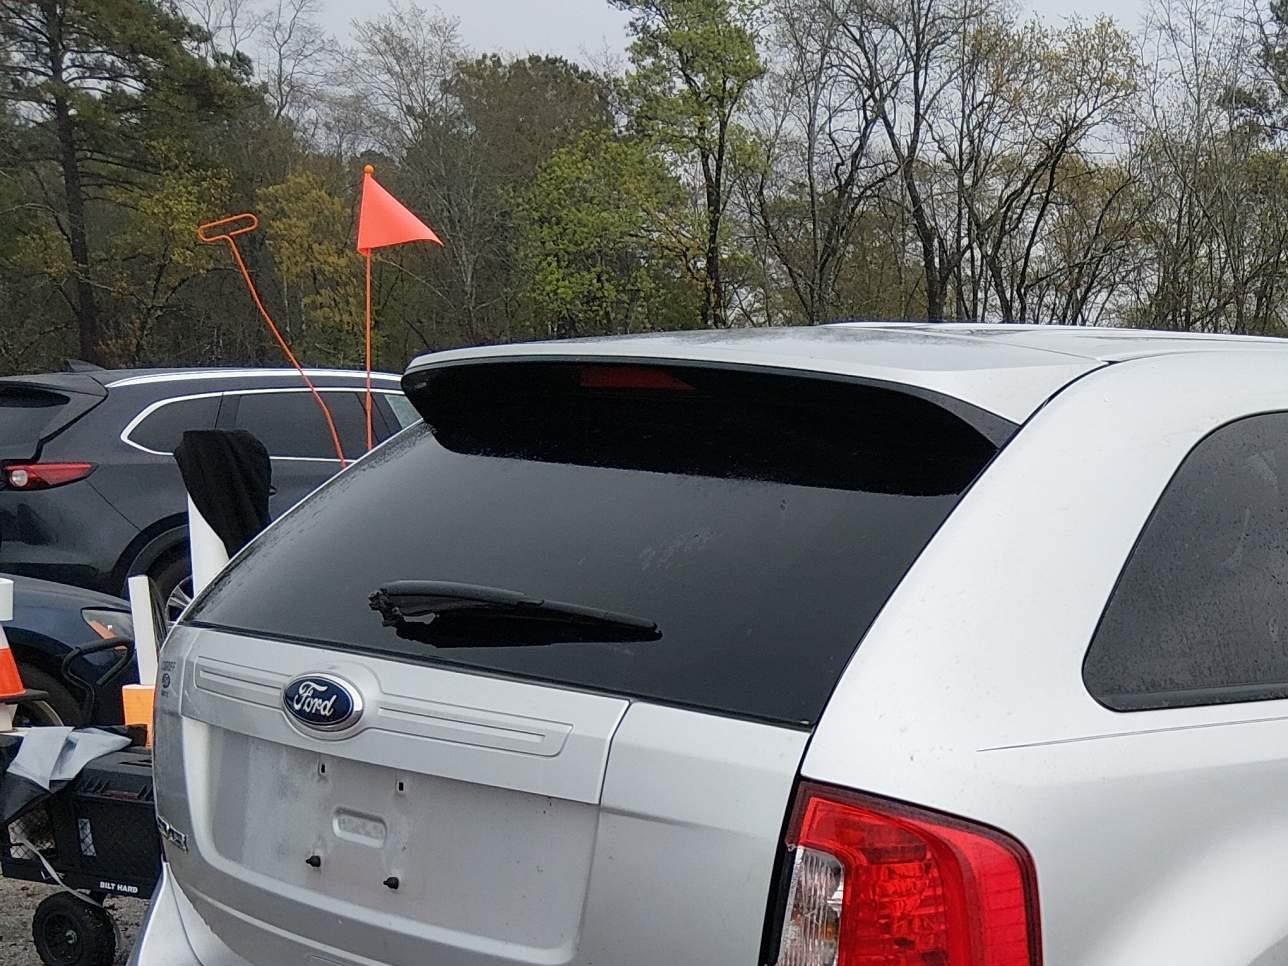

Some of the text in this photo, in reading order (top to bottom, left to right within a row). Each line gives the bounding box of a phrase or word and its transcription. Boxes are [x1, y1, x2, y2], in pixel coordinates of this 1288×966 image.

[293, 681, 337, 716] Ford
[100, 881, 138, 893] BILT HARD
